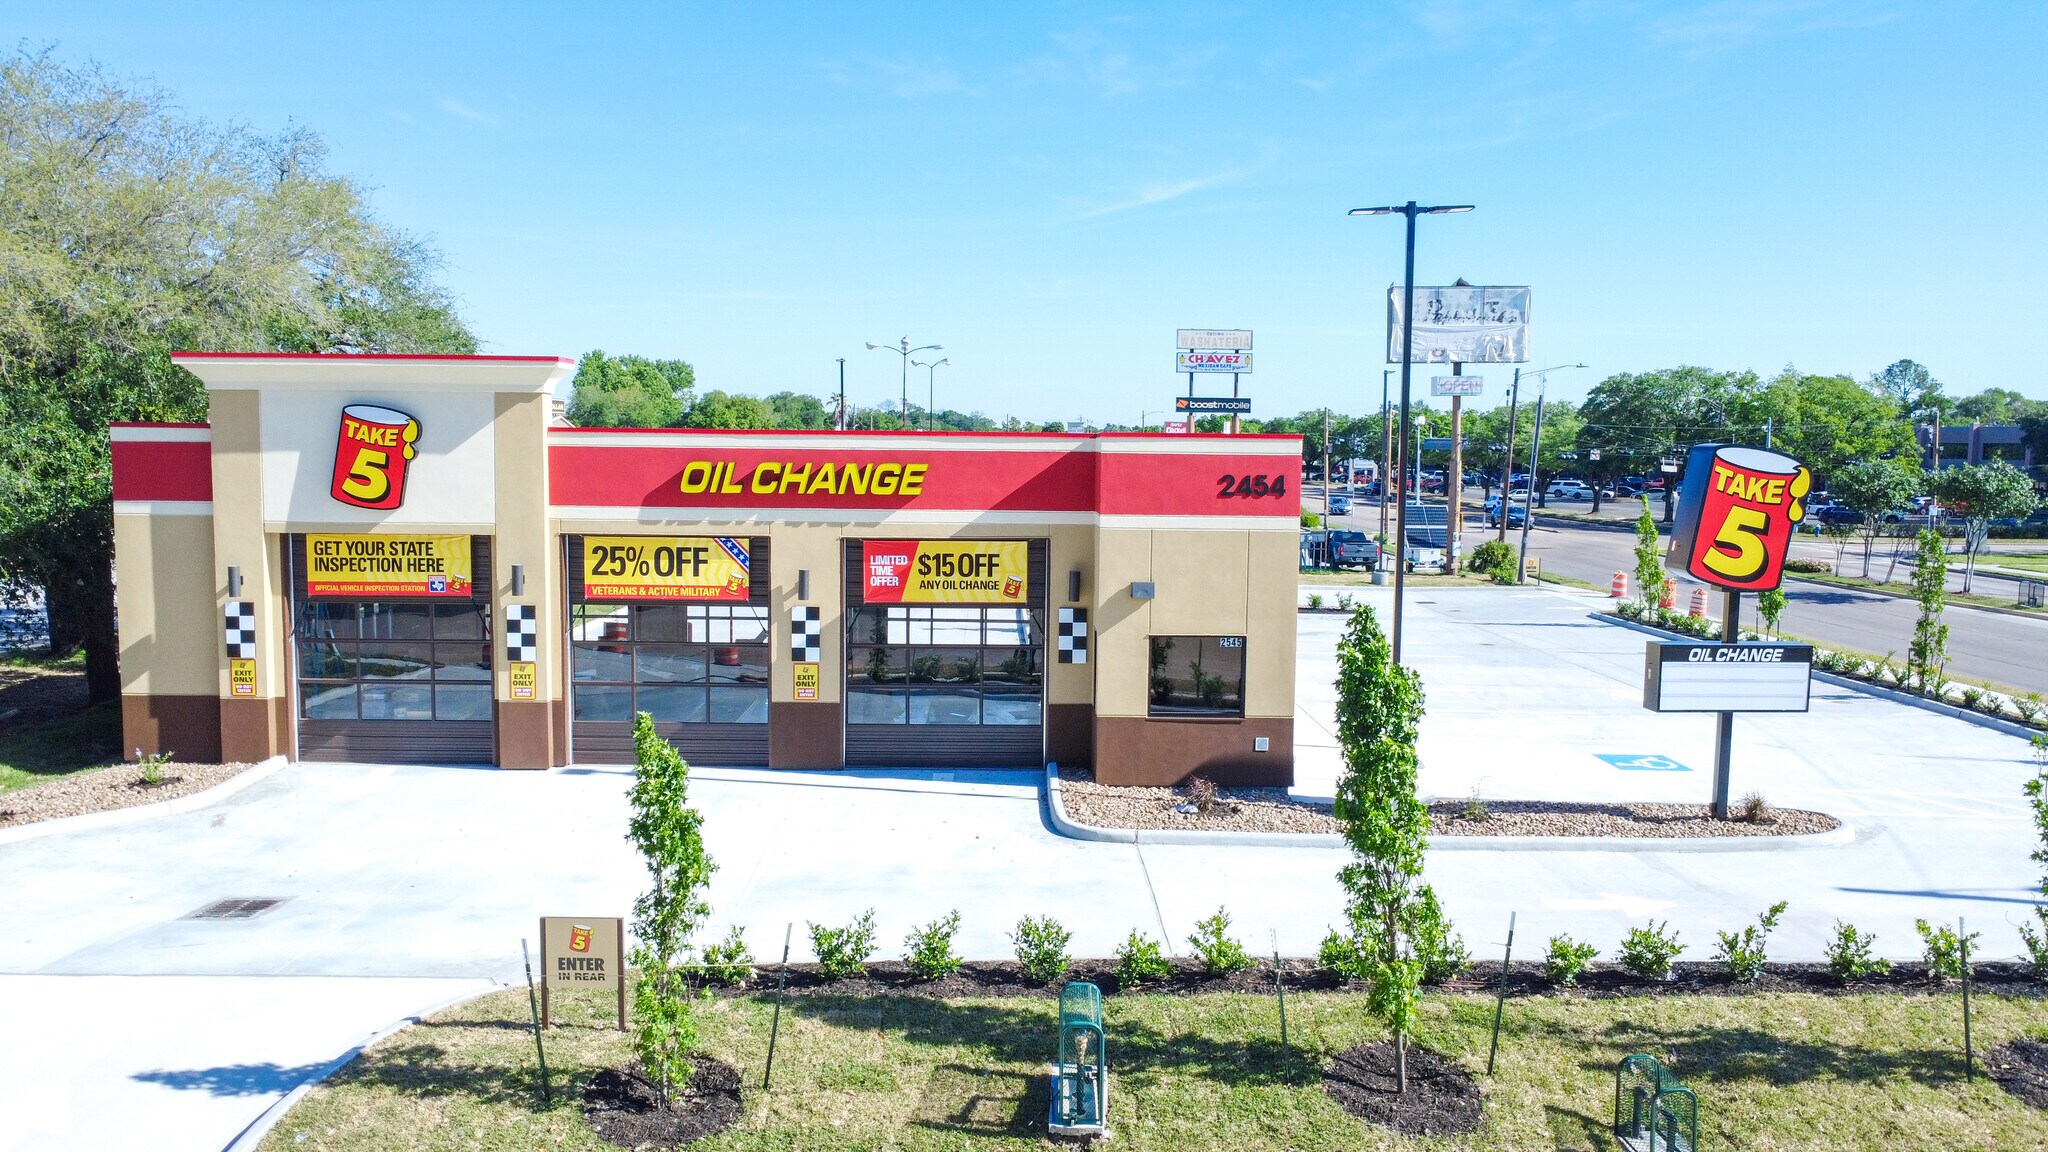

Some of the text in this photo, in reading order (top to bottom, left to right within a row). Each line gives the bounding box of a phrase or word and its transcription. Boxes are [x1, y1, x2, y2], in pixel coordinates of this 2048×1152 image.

[1180, 334, 1250, 348] WASHATERIA
[1188, 354, 1241, 364] CHAVEZ
[1444, 380, 1478, 391] OPEN
[344, 419, 398, 446] TAKE
[341, 447, 390, 502] 5
[680, 461, 929, 496] OIL CHANGE
[1218, 474, 1286, 498] 2454
[1714, 465, 1786, 505] TAKE
[314, 540, 434, 556] GET YOUR STATE
[1702, 505, 1769, 581] 5
[314, 558, 444, 572] INSPECTION HERE
[591, 546, 709, 577] 25% OFF
[870, 556, 908, 565] LIMITED
[918, 552, 1000, 578] $15 OFF
[870, 566, 893, 576] TIME
[870, 577, 898, 586] OFFER
[920, 580, 1000, 590] ANY OIL CHANGE
[592, 586, 720, 597] VETERANS & ACTIVE MILITARY
[1220, 638, 1242, 647] 2545
[1688, 648, 1784, 662] OIL CHANGE
[573, 928, 590, 936] TAKE
[572, 936, 586, 950] 5
[558, 957, 605, 971] ENTER
[558, 972, 606, 981] IN REAR
